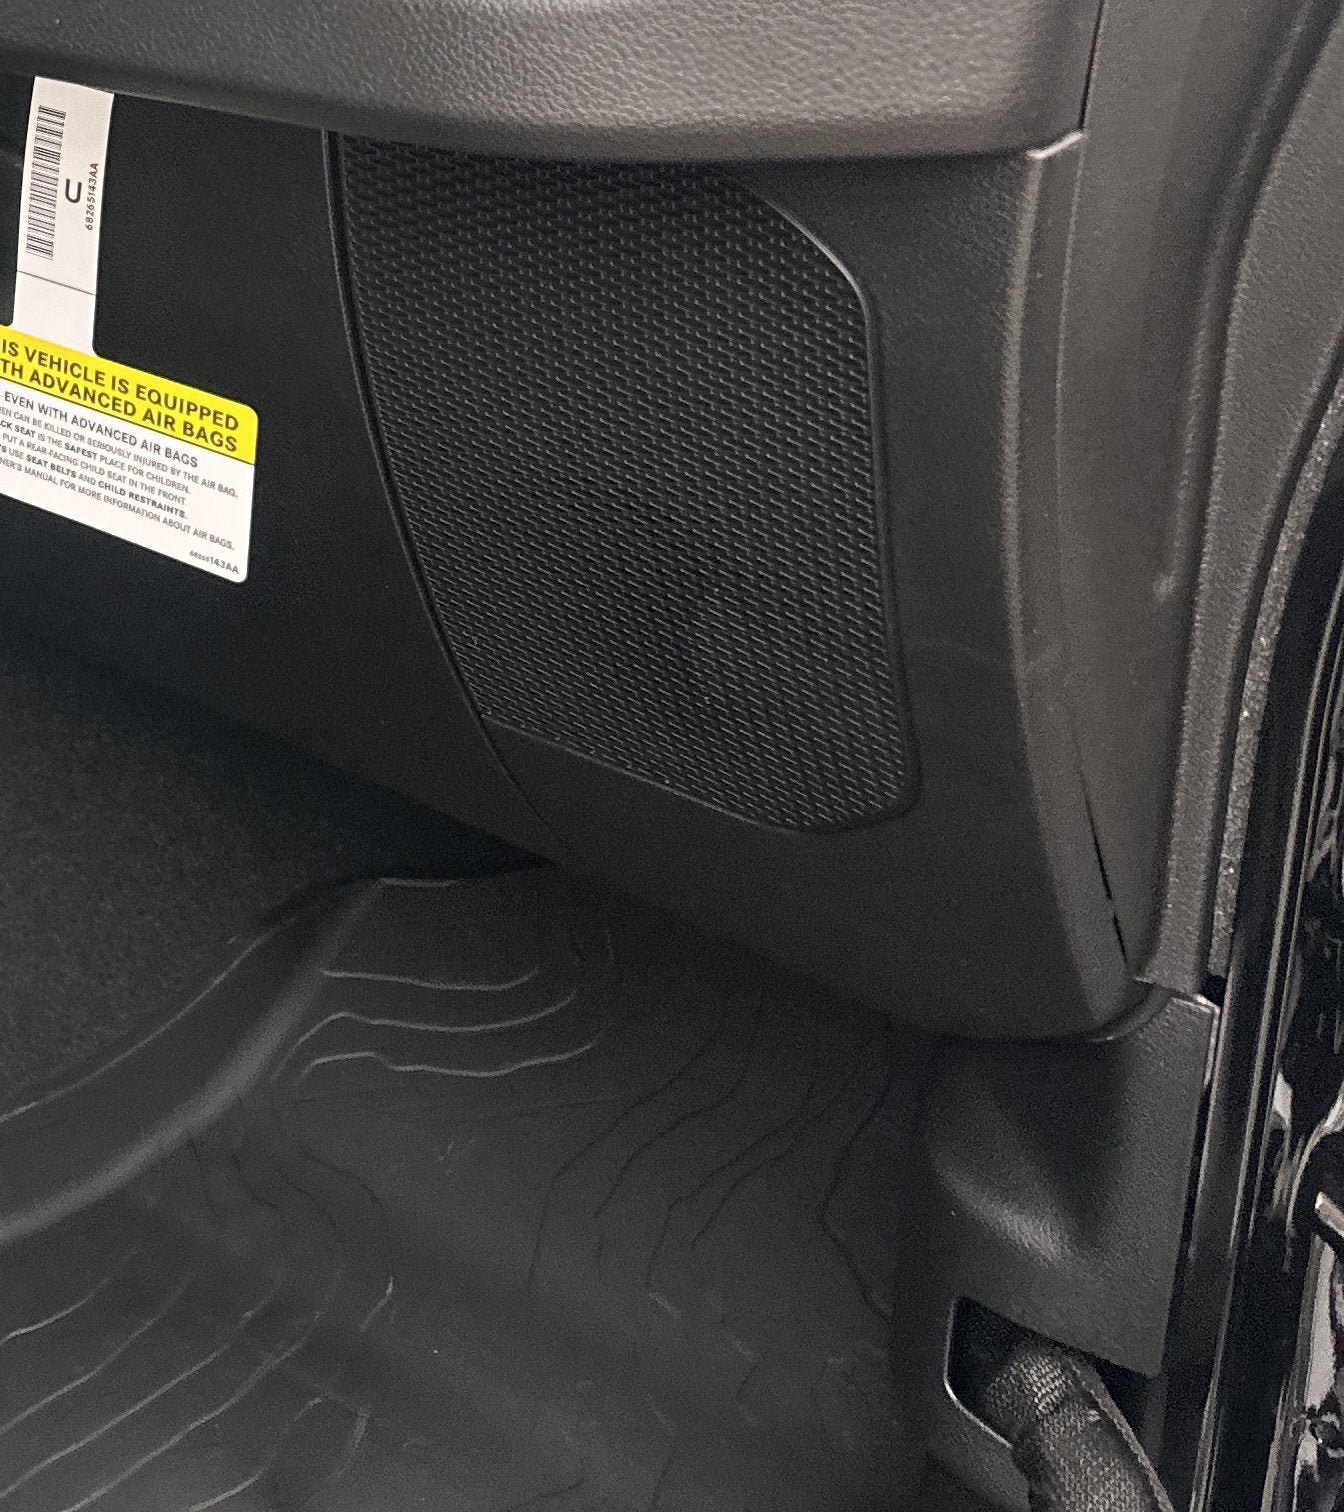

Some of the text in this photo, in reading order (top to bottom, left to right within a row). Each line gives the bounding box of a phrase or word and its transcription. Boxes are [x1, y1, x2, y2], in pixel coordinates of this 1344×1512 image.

[65, 178, 82, 203] U
[85, 163, 99, 231] 68265143AA
[23, 345, 105, 388] VEHICLE
[111, 374, 129, 396] IS
[135, 383, 239, 433] EQUIPPED
[28, 367, 137, 418] ADVANCED
[142, 406, 176, 433] AIR
[182, 420, 237, 453] BAGS
[4, 389, 198, 469] EVEN WITH ADVANCED AIR BAGS
[13, 409, 30, 424] CAN
[32, 416, 42, 428] BE
[44, 420, 71, 439] KILLED
[73, 431, 85, 444] OR
[87, 436, 130, 460] SERIOUSLY
[133, 452, 167, 474] INJURED
[170, 466, 181, 478] BY
[183, 470, 199, 485] THE
[201, 477, 215, 491] AIR
[14, 422, 35, 439] SEAT
[37, 431, 45, 442] IS
[48, 434, 62, 449] THE
[64, 440, 97, 461] SAFEST
[99, 453, 125, 471] PLACE
[127, 463, 144, 478] FOR
[146, 470, 191, 495] CHILDREN.
[2, 431, 17, 445] PUT
[18, 437, 24, 448] A
[26, 439, 78, 467] REAR-FACING
[80, 459, 104, 477] CHILD
[106, 468, 126, 484] SEAT
[128, 476, 137, 488] IN
[139, 480, 155, 495] THE
[157, 487, 186, 506] FRONT.
[8, 446, 24, 461] USE
[26, 452, 48, 469] SEAT
[50, 461, 76, 479] BELTS
[78, 471, 96, 487] AND
[98, 478, 125, 497] CHILD
[128, 489, 187, 519] RESTRAINTS.
[24, 465, 58, 485] MANUAL
[60, 477, 76, 492] FOR
[78, 484, 101, 502] MORE
[103, 493, 160, 523] INFORMATION
[162, 515, 190, 534] ABOUT
[192, 526, 207, 540] AIR
[209, 532, 234, 550] BAGS.
